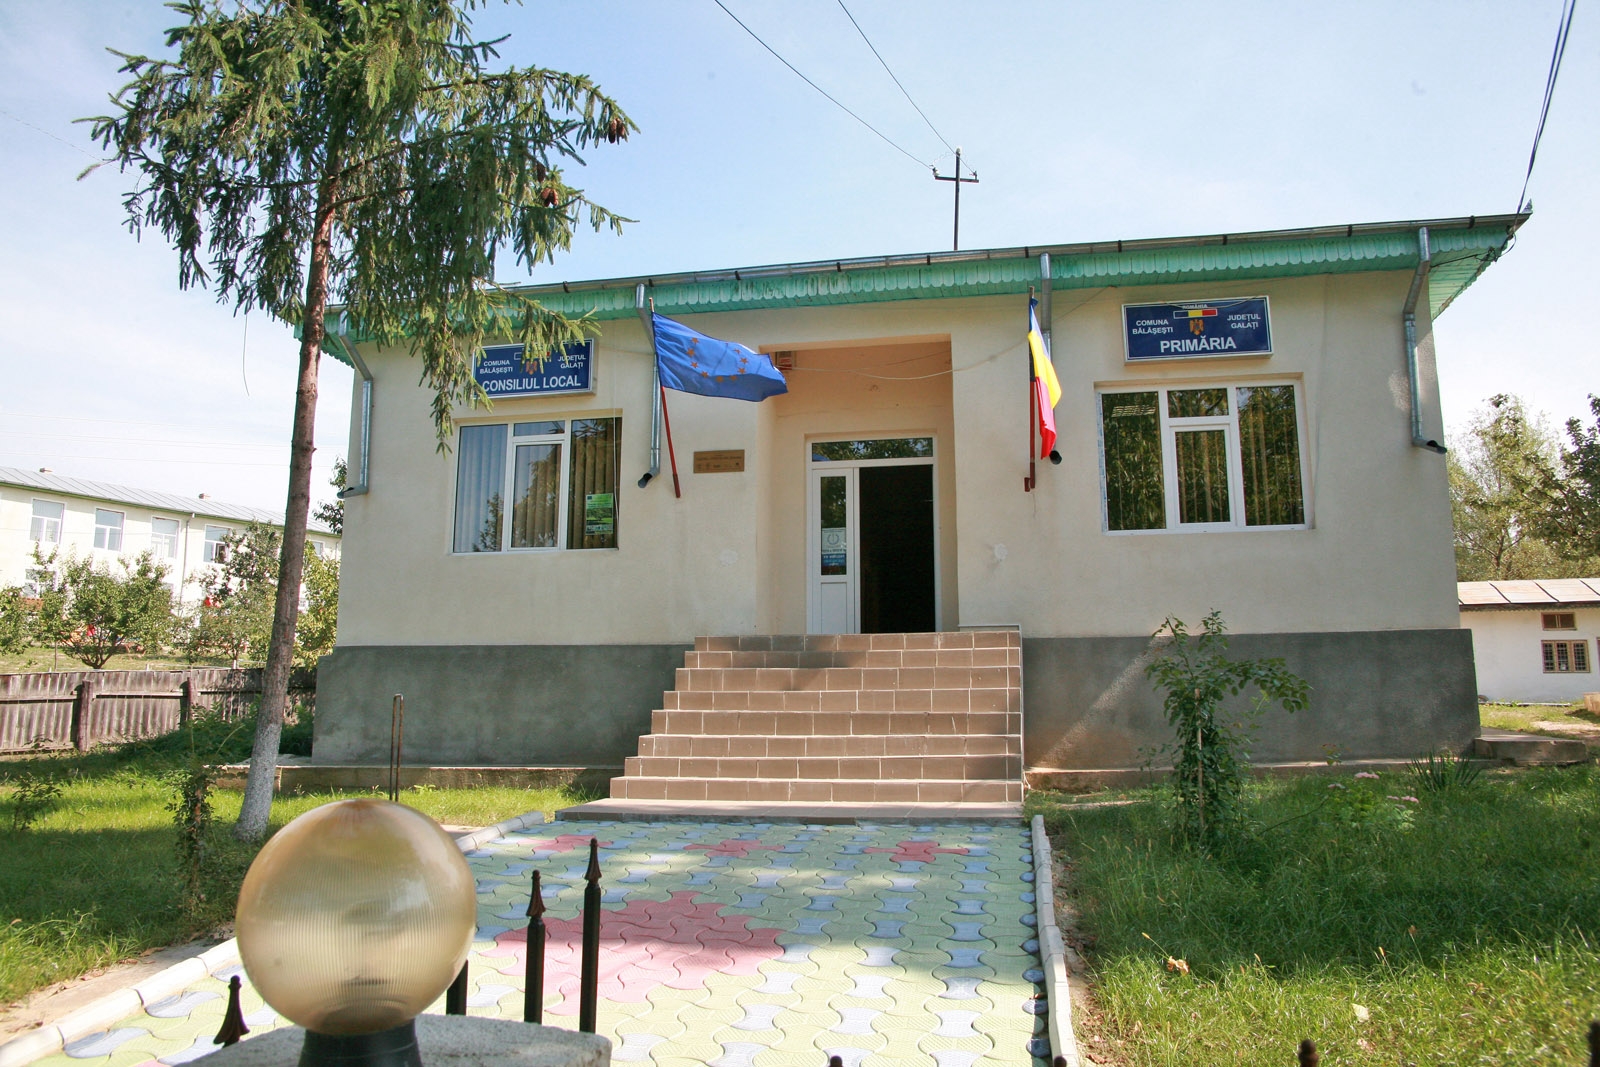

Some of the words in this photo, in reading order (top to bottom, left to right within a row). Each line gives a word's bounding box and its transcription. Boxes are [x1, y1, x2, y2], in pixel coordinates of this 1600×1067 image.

[1160, 335, 1237, 353] PRIMĂRIA
[482, 377, 540, 392] CONSILIUL
[543, 375, 581, 388] LOCAL
